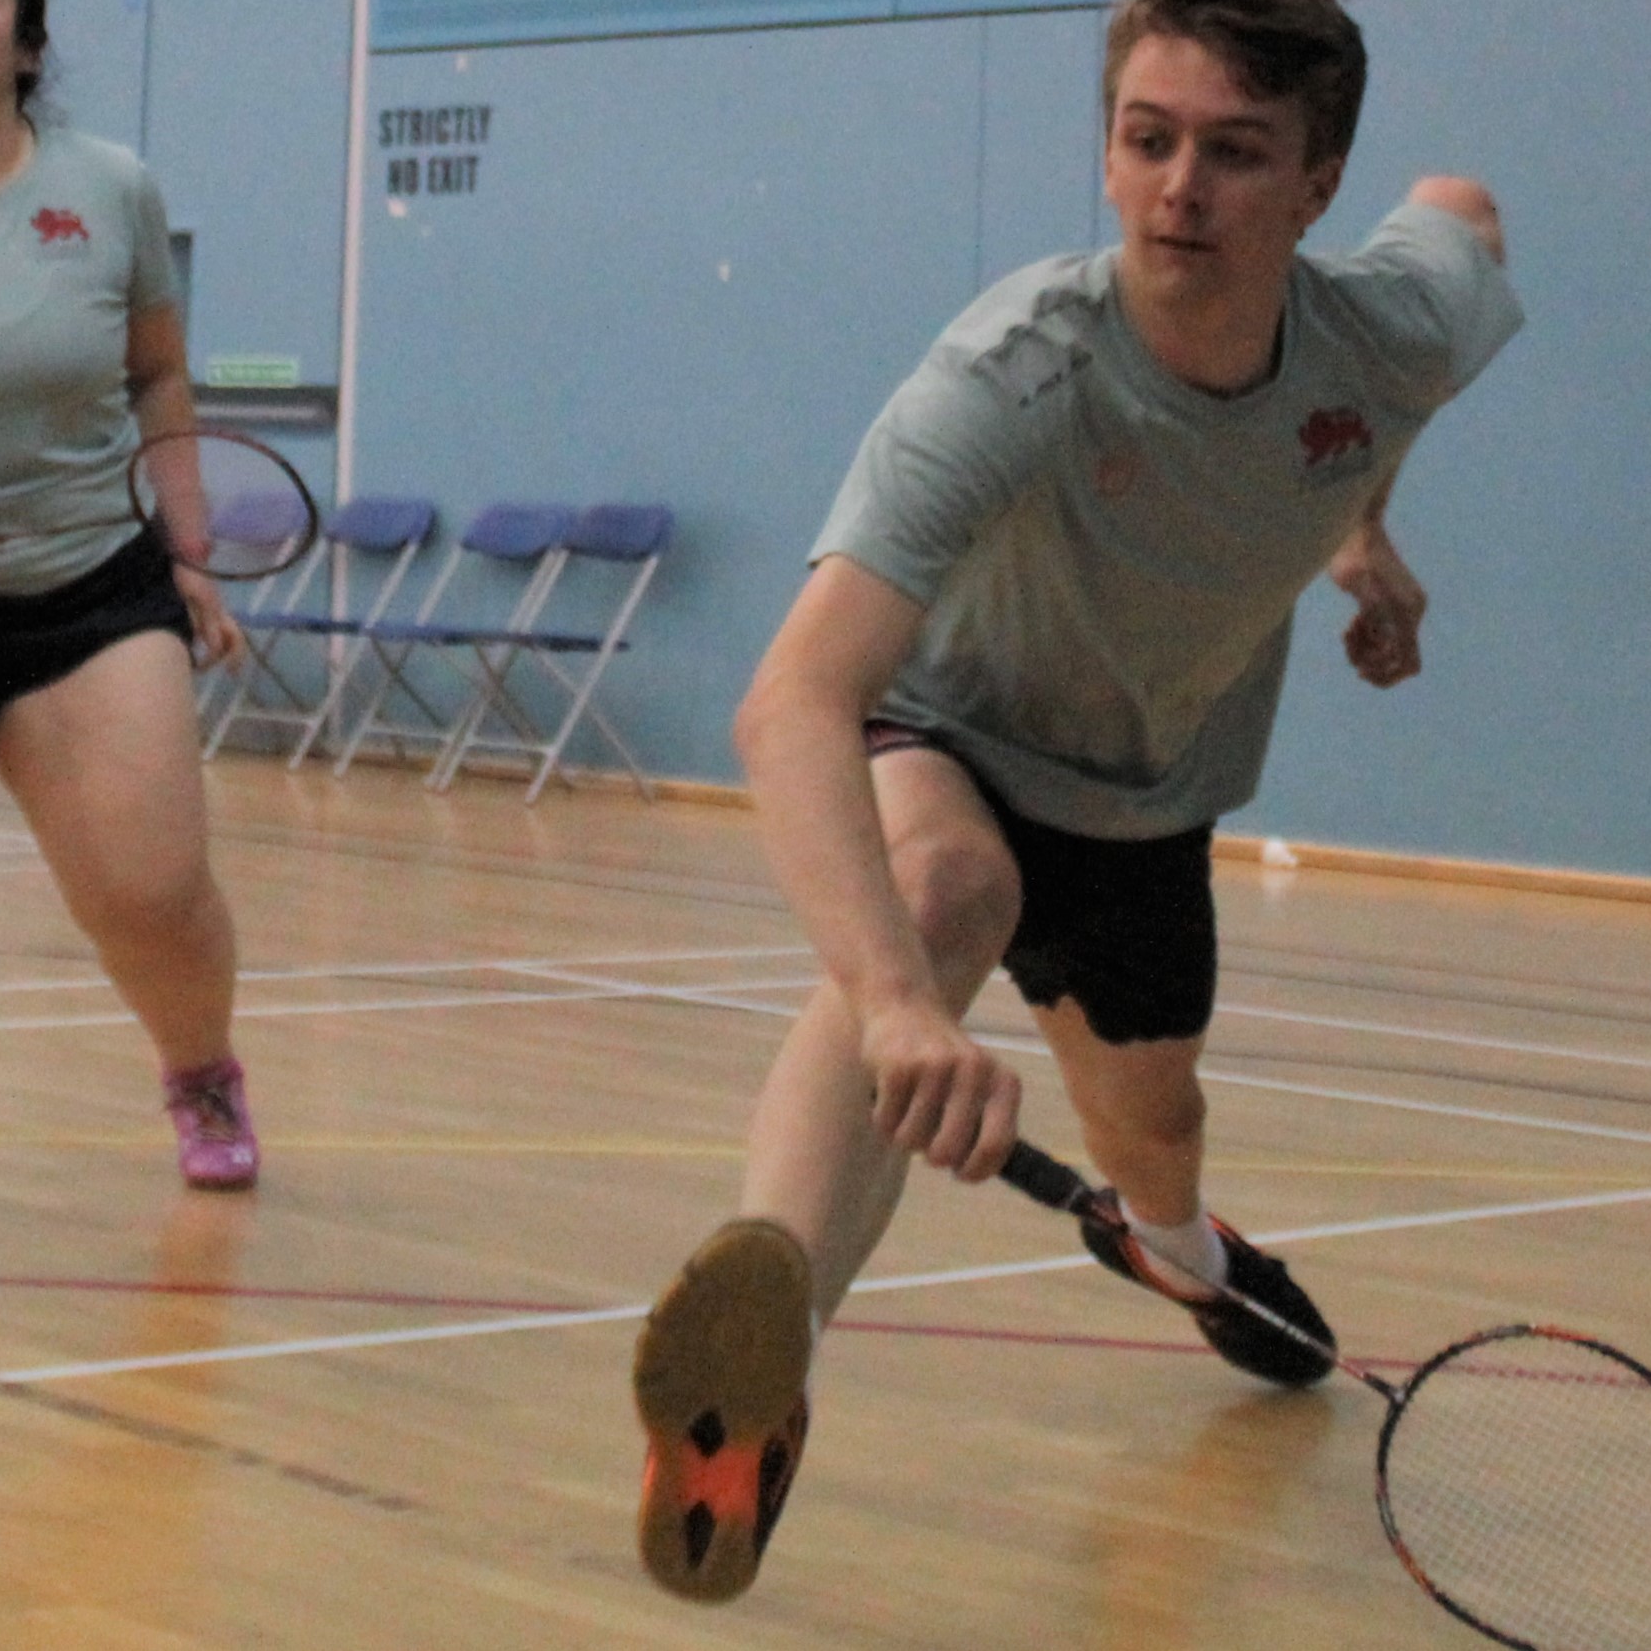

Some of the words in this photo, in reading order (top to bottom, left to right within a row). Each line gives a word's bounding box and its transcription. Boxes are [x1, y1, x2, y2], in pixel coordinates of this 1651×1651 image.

[379, 105, 492, 148] STRICTLY
[388, 158, 418, 196] NO
[428, 156, 478, 195] EXIT
